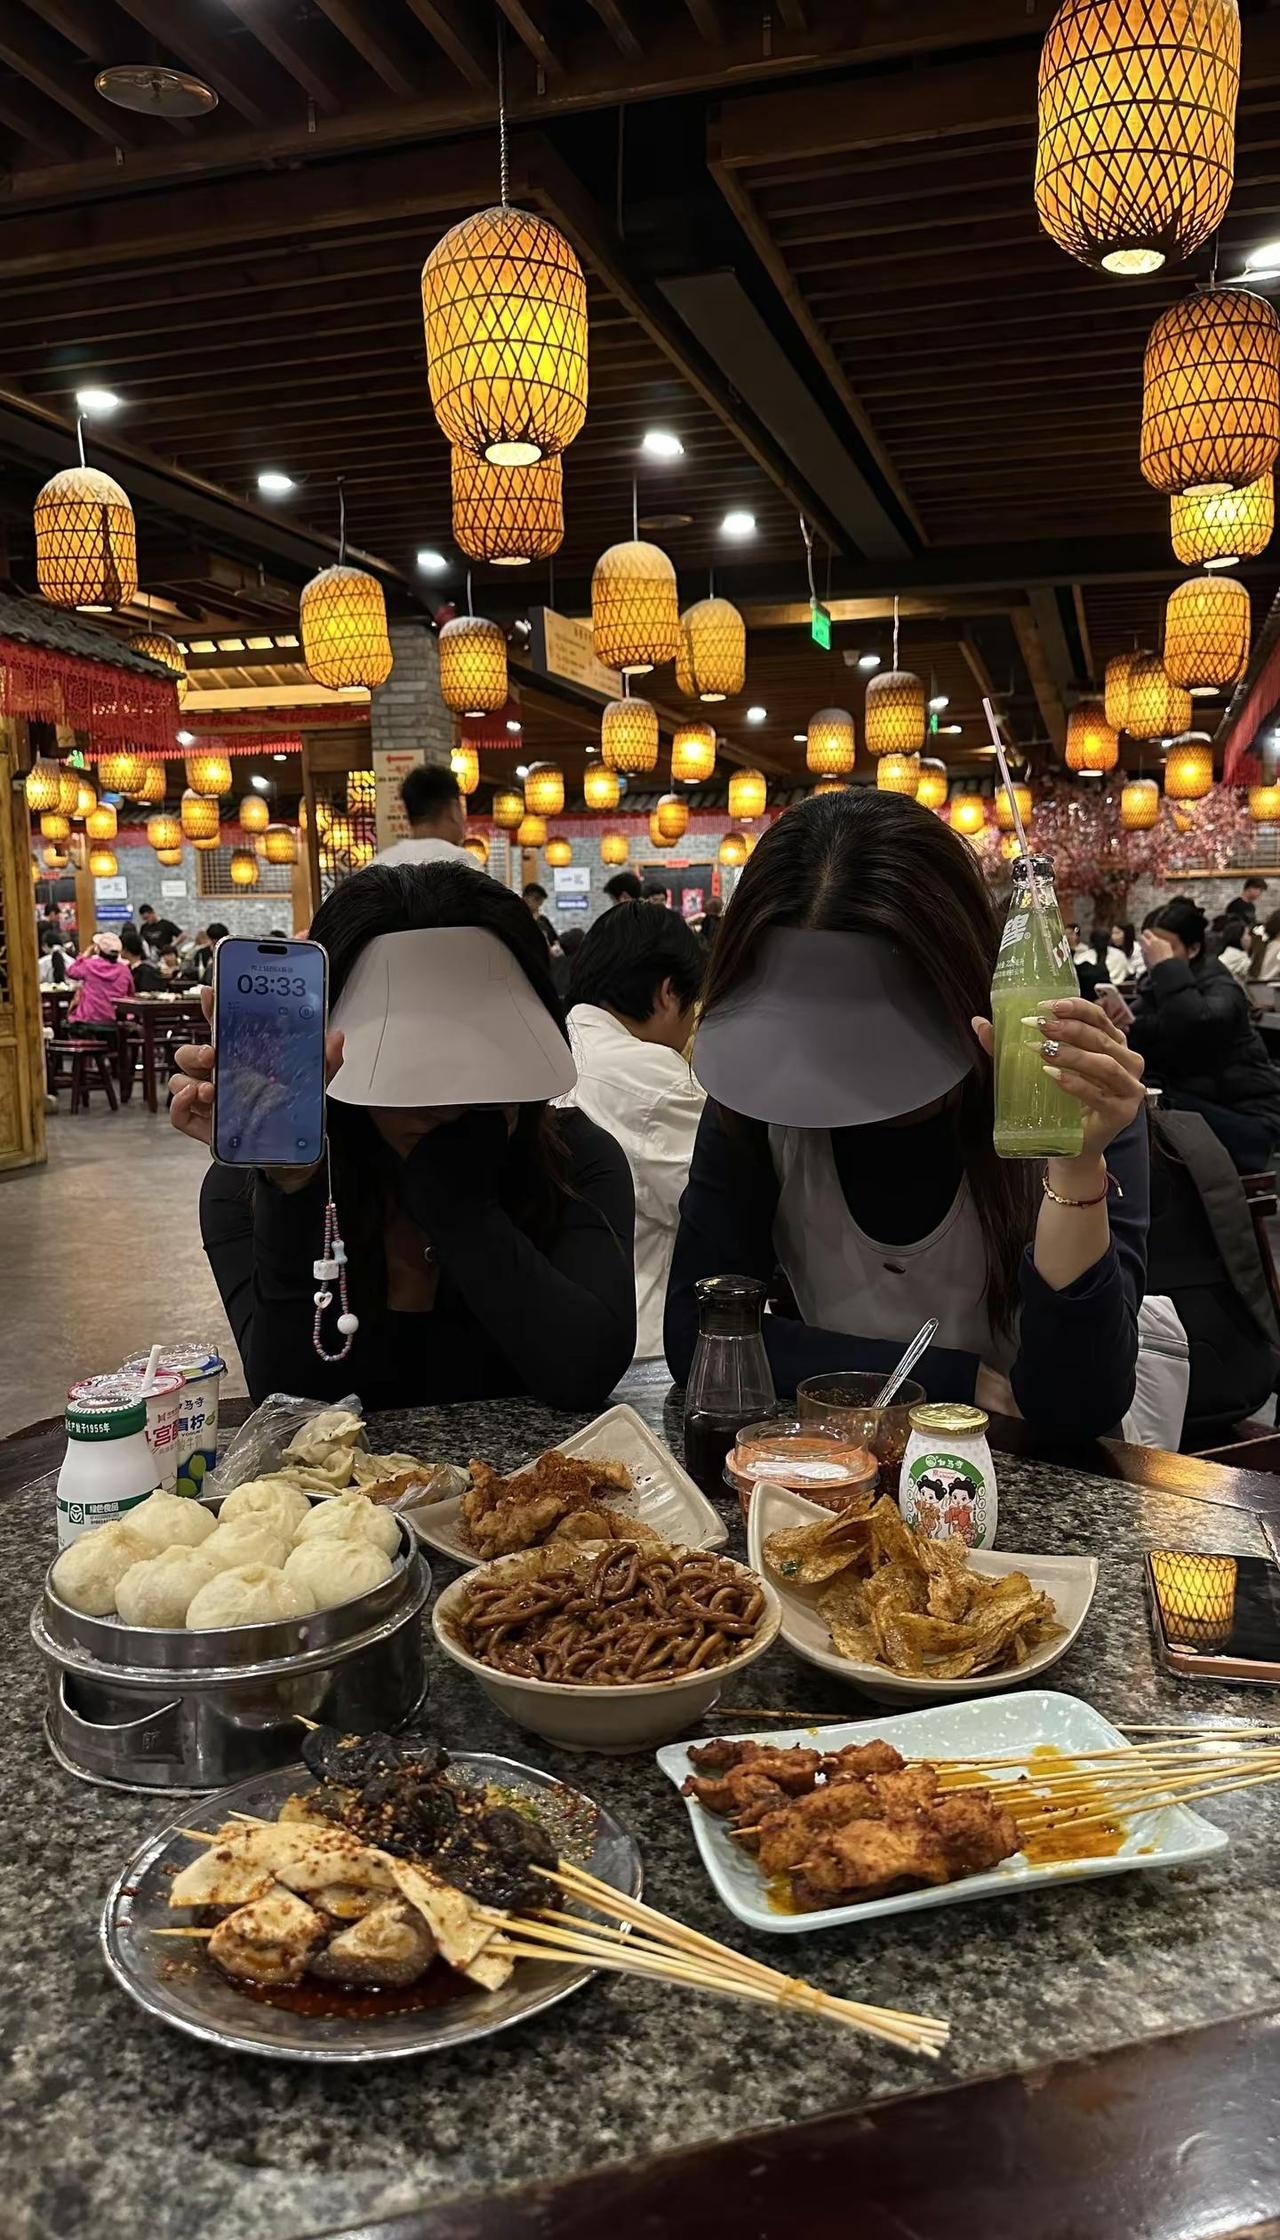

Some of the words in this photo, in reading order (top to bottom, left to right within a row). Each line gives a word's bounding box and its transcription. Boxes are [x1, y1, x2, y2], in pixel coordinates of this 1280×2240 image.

[237, 974, 306, 997] 03:33
[89, 1502, 119, 1513] 绿色食品
